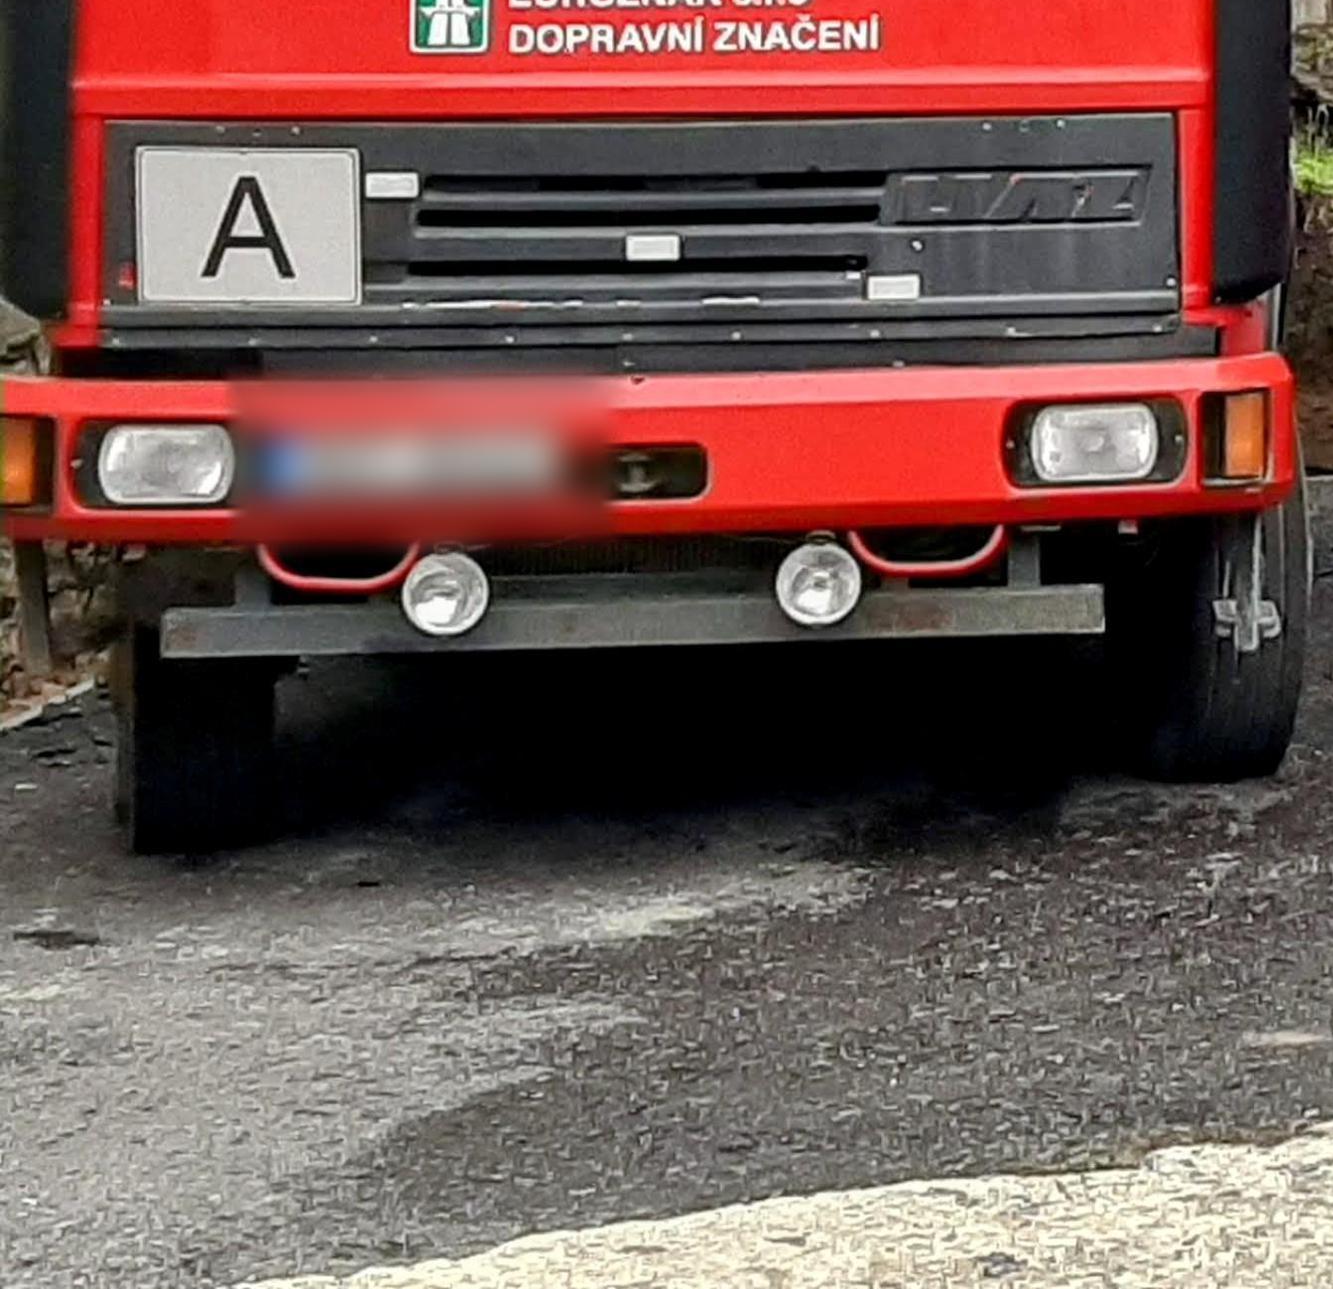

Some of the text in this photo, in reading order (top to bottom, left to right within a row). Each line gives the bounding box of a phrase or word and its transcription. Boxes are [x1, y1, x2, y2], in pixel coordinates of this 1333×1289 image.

[507, 13, 880, 54] DOPRAVNÍ ZNAČENÍ
[199, 175, 296, 279] A
